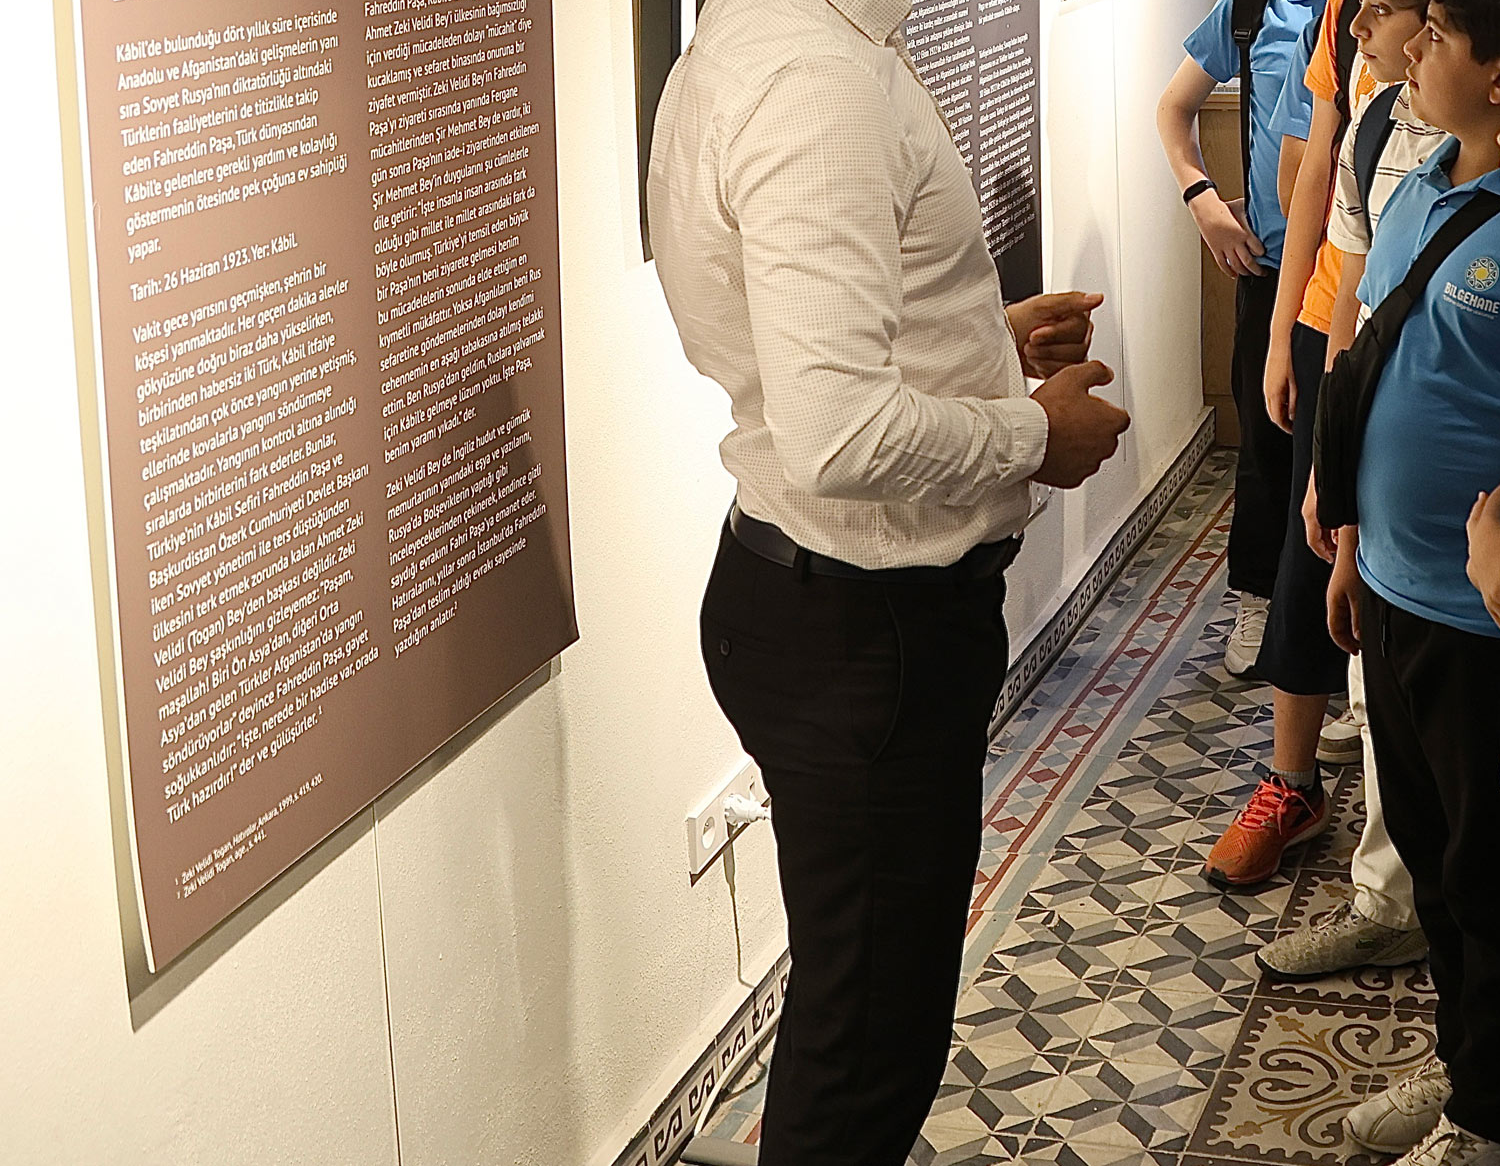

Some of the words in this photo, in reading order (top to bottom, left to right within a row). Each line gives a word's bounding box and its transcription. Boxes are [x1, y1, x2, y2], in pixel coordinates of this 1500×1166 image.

[163, 28, 221, 54] bulunduğu
[222, 24, 245, 43] dört
[245, 18, 271, 43] yıllık
[271, 16, 293, 34] süre
[293, 7, 338, 33] içerisinde
[364, 22, 393, 41] Ahmet
[392, 17, 411, 36] Zeki
[410, 12, 434, 31] Velidi
[452, 3, 487, 23] ülkesinin
[117, 66, 164, 91] Anadolu
[165, 65, 179, 81] ve
[259, 36, 318, 66] gelişmelerin
[318, 34, 339, 54] yanı
[118, 102, 141, 119] sıra
[142, 91, 180, 114] Sovyet
[231, 65, 291, 95] diktatörlüğü
[292, 57, 332, 81] altındaki
[120, 120, 171, 147] Türklerin
[171, 103, 238, 135] faaliyetlerini
[239, 101, 253, 119] de
[253, 92, 294, 116] titizlikle
[294, 86, 319, 106] takip
[122, 155, 151, 175] eden
[152, 139, 207, 168] Fahreddin
[208, 135, 236, 154] Paşa,
[234, 126, 258, 146] Türk
[258, 113, 318, 141] dünyasından
[125, 197, 195, 236] göstermenin
[195, 184, 240, 211] ötesinde
[241, 177, 261, 202] pek
[260, 170, 296, 196] çoğuna
[296, 166, 309, 182] ev
[309, 152, 347, 178] sahipliği
[163, 167, 214, 197] gelenlere
[215, 153, 250, 183] gerekli
[250, 147, 285, 173] yardım
[285, 144, 298, 159] ve
[298, 131, 338, 156] kolaylığı
[127, 237, 161, 264] yapar.
[129, 277, 162, 301] Tarih:
[163, 270, 178, 291] 26
[179, 260, 220, 285] Haziran
[221, 247, 251, 271] 1923.
[249, 243, 270, 261] Yer:
[270, 231, 298, 255] Kâbil.
[205, 504, 233, 532] Kâbil
[233, 489, 261, 518] Sefiri
[261, 468, 309, 504] Fahreddin
[309, 458, 331, 479] Paşa
[331, 452, 343, 468] ve
[386, 482, 439, 521] memurlarının
[438, 458, 474, 495] yanındaki
[474, 452, 491, 472] eşya
[490, 447, 500, 461] ve
[499, 430, 532, 459] yazılarını,
[148, 542, 217, 589] Başkurdistan
[217, 524, 248, 552] Özerk
[247, 492, 305, 536] Cumhuriyeti
[305, 479, 336, 507] Devlet
[335, 462, 369, 490] Başkanı
[152, 603, 194, 642] ülkesini
[195, 592, 217, 618] terk
[217, 574, 250, 605] etmek
[250, 554, 289, 588] zorunda
[289, 540, 316, 565] kalan
[315, 522, 346, 551] Ahmet
[345, 509, 364, 534] Zeki
[152, 635, 185, 668] Velidi
[186, 614, 225, 653] (Togan)
[265, 573, 301, 604] başkası
[301, 551, 338, 583] değildir.
[336, 538, 356, 563] Zeki
[426, 586, 451, 611] teslim
[450, 570, 472, 595] aldığı
[471, 557, 494, 580] evrakı
[493, 536, 527, 567] sayesinde
[165, 796, 191, 824] Türk
[238, 753, 256, 776] der
[255, 745, 269, 763] ve
[269, 711, 318, 758] gülüşürler.
